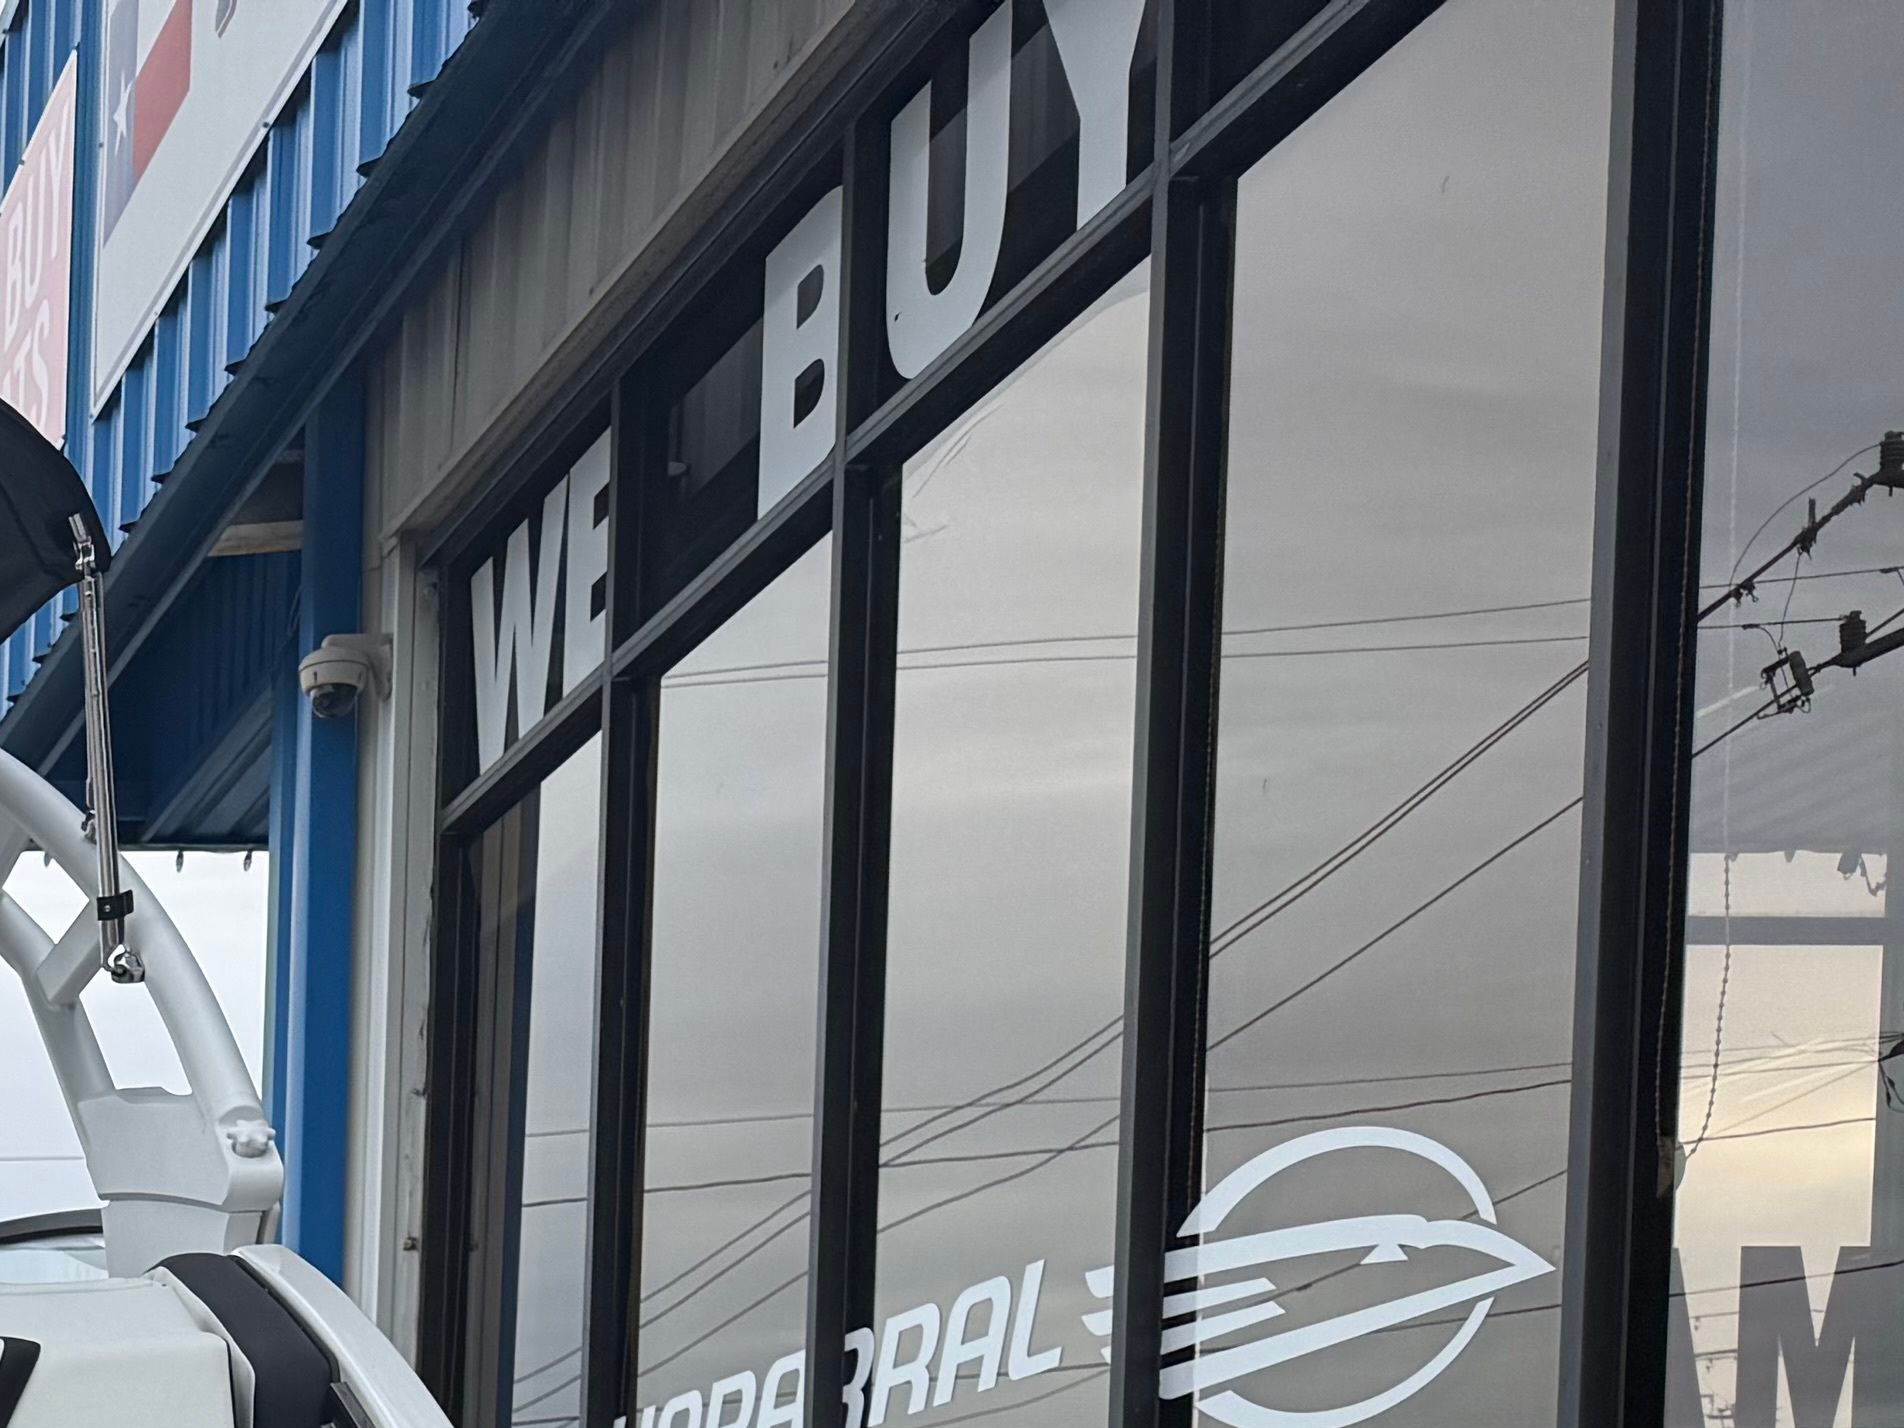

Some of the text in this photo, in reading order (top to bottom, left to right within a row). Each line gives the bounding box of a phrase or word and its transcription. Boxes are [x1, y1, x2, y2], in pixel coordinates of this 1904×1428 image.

[3, 98, 69, 353] BUY
[471, 0, 1143, 776] WE BUY
